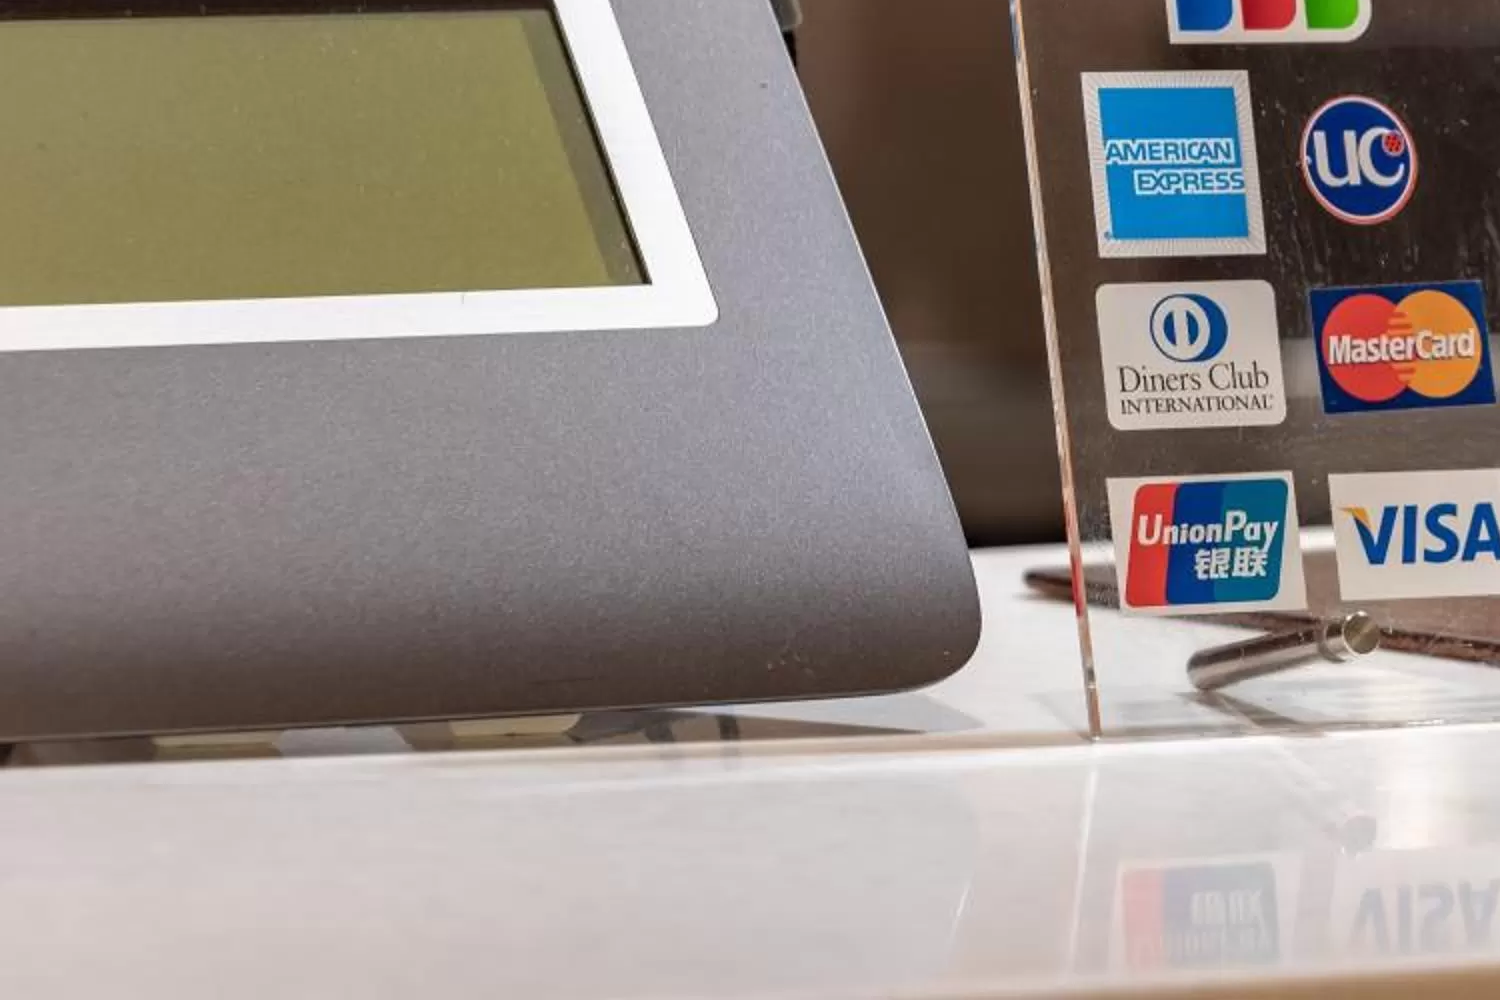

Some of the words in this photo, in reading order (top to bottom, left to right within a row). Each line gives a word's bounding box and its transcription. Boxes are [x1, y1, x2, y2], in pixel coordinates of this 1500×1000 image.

[1105, 138, 1232, 164] AMERICAN
[1312, 127, 1404, 186] UC
[1136, 171, 1244, 193] EXPRESS
[1328, 330, 1475, 367] MasterCard
[1118, 364, 1202, 394] Diners
[1208, 362, 1270, 390] Club
[1120, 395, 1272, 415] INTERNATIONAL
[1136, 510, 1279, 552] UnionPay
[1194, 546, 1268, 580] 银联
